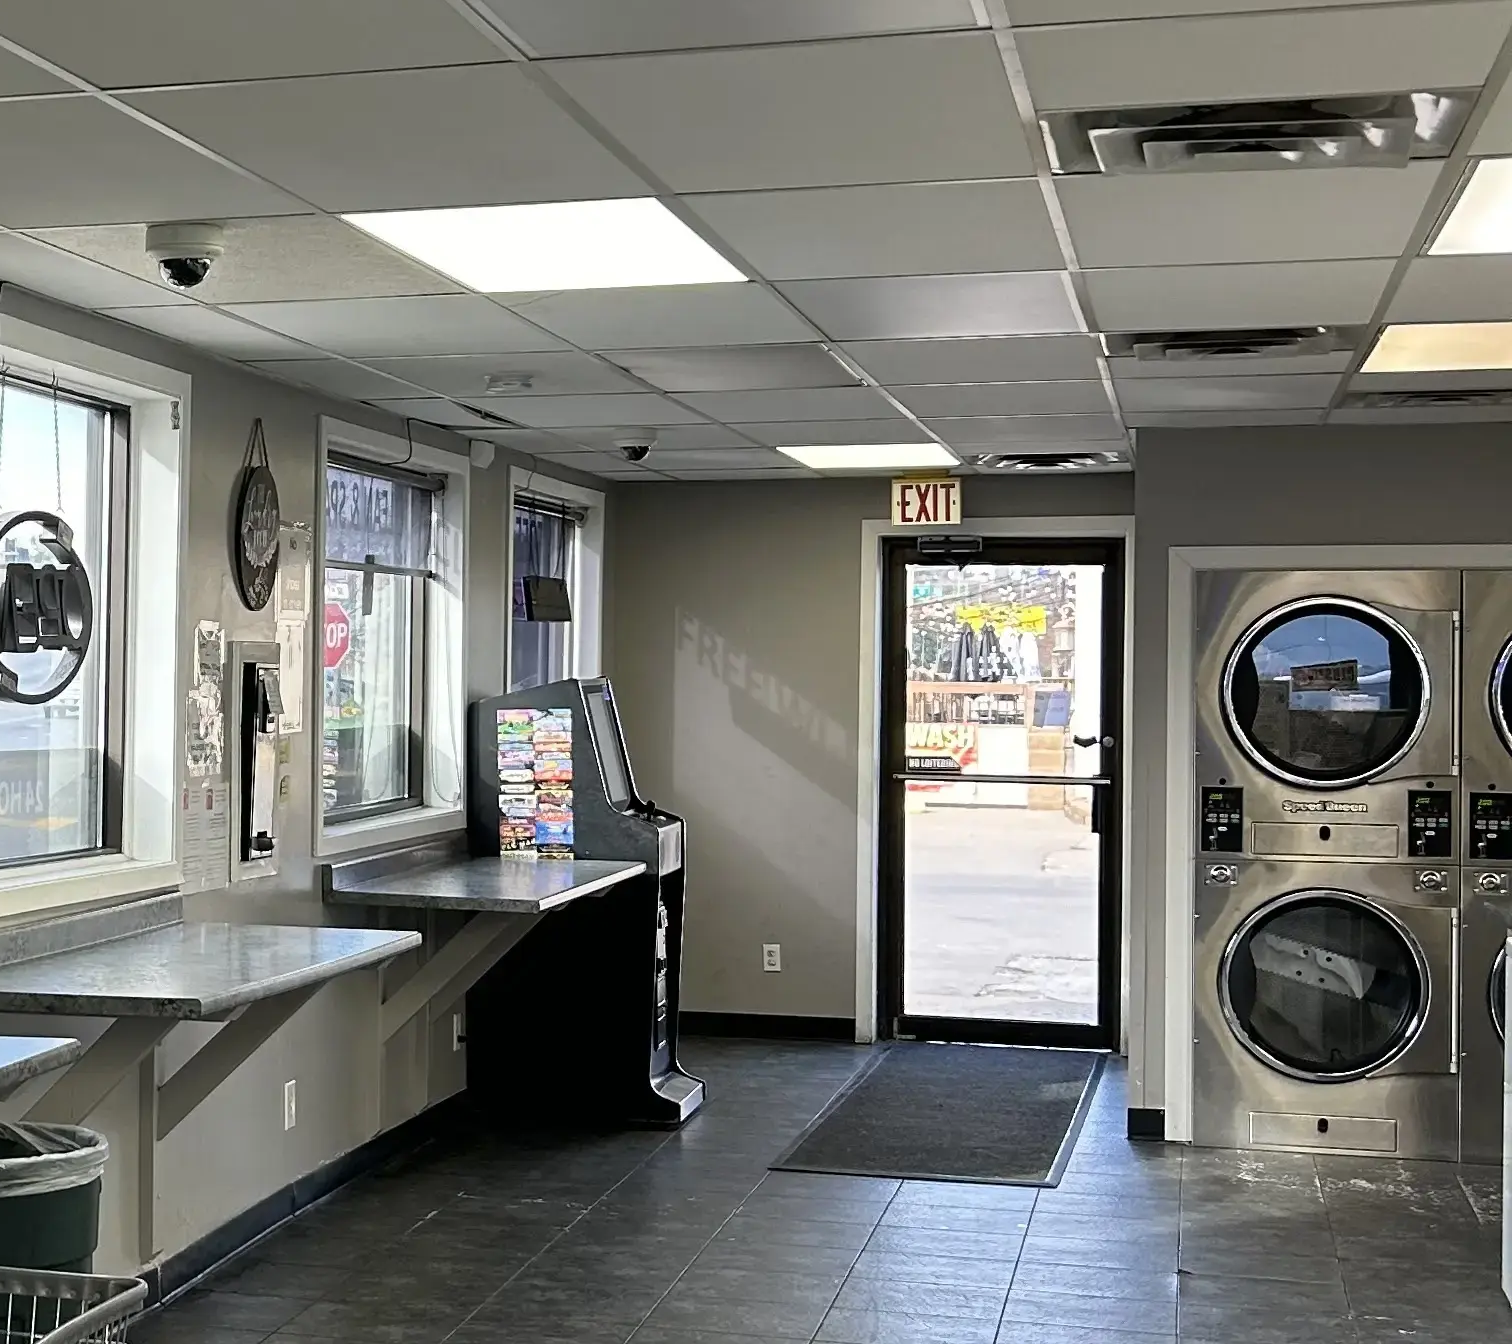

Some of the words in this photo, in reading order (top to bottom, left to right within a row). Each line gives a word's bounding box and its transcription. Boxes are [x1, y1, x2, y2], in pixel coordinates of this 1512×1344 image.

[900, 483, 955, 522] EXIT
[324, 622, 348, 649] OP
[906, 722, 975, 748] WASH
[1282, 799, 1325, 813] Speed
[1326, 801, 1368, 812] Queen
